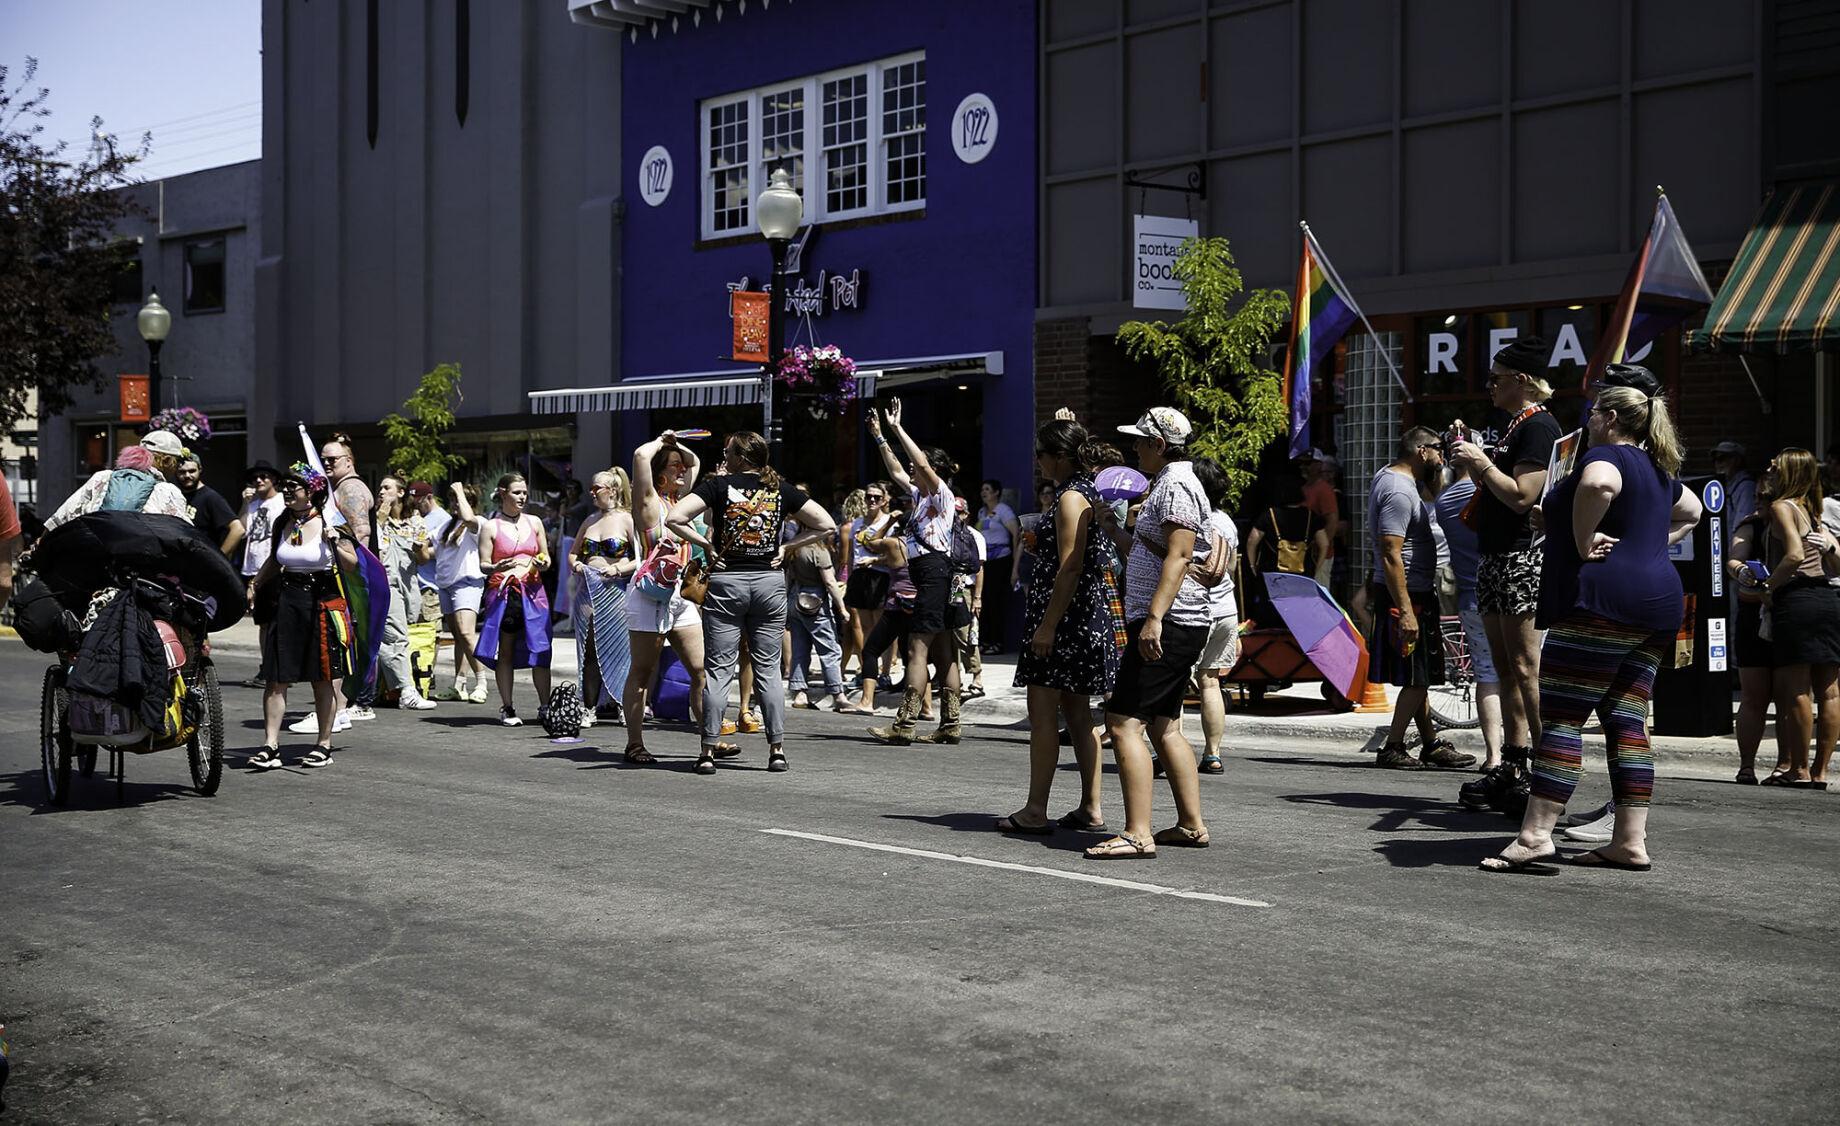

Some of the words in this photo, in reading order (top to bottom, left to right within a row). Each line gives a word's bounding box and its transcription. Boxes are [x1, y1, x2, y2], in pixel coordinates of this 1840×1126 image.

[962, 106, 990, 152] 1922
[646, 157, 668, 195] 1922
[829, 268, 860, 311] Pot
[1138, 280, 1154, 290] co.
[1710, 486, 1720, 508] P
[1712, 520, 1720, 551] PAY
[1713, 554, 1722, 594] HERE
